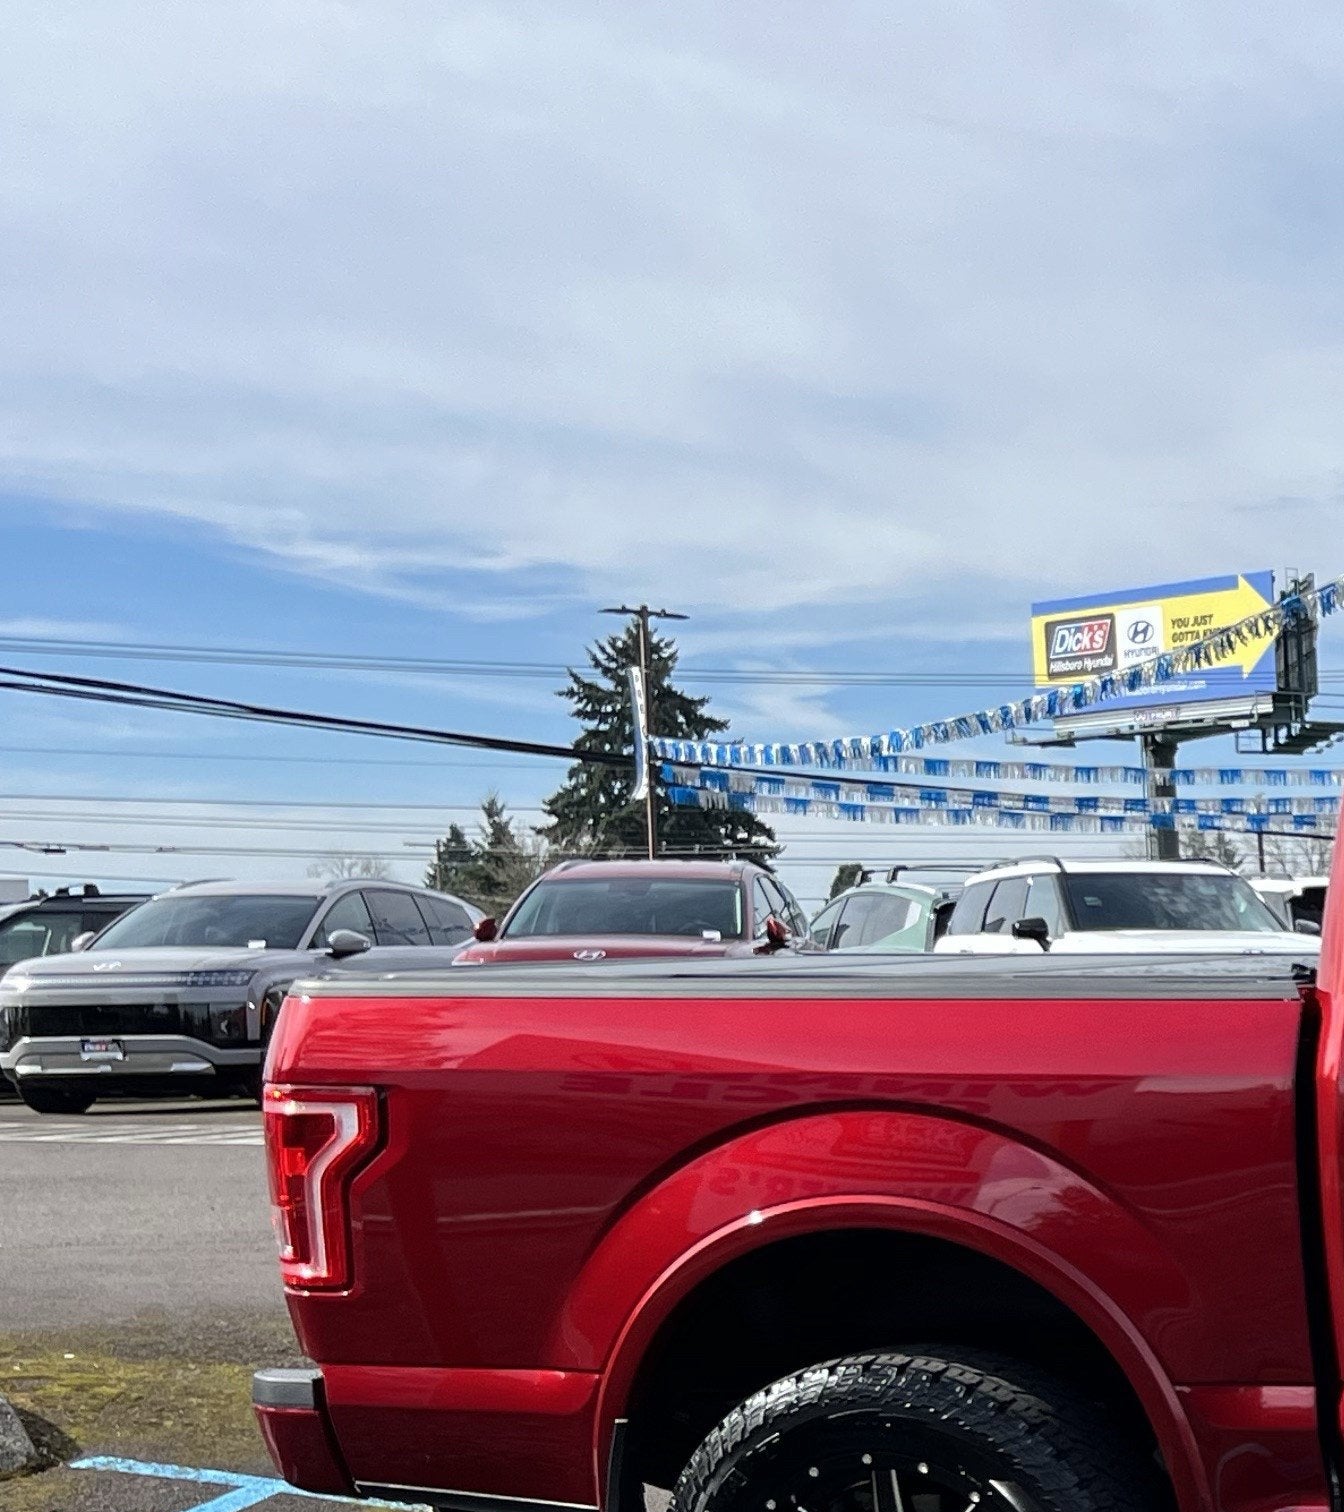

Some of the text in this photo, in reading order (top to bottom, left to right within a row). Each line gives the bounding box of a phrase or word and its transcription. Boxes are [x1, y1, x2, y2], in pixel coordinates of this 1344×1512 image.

[1171, 614, 1214, 629] YOU JUST
[1171, 630, 1201, 643] GOTTA
